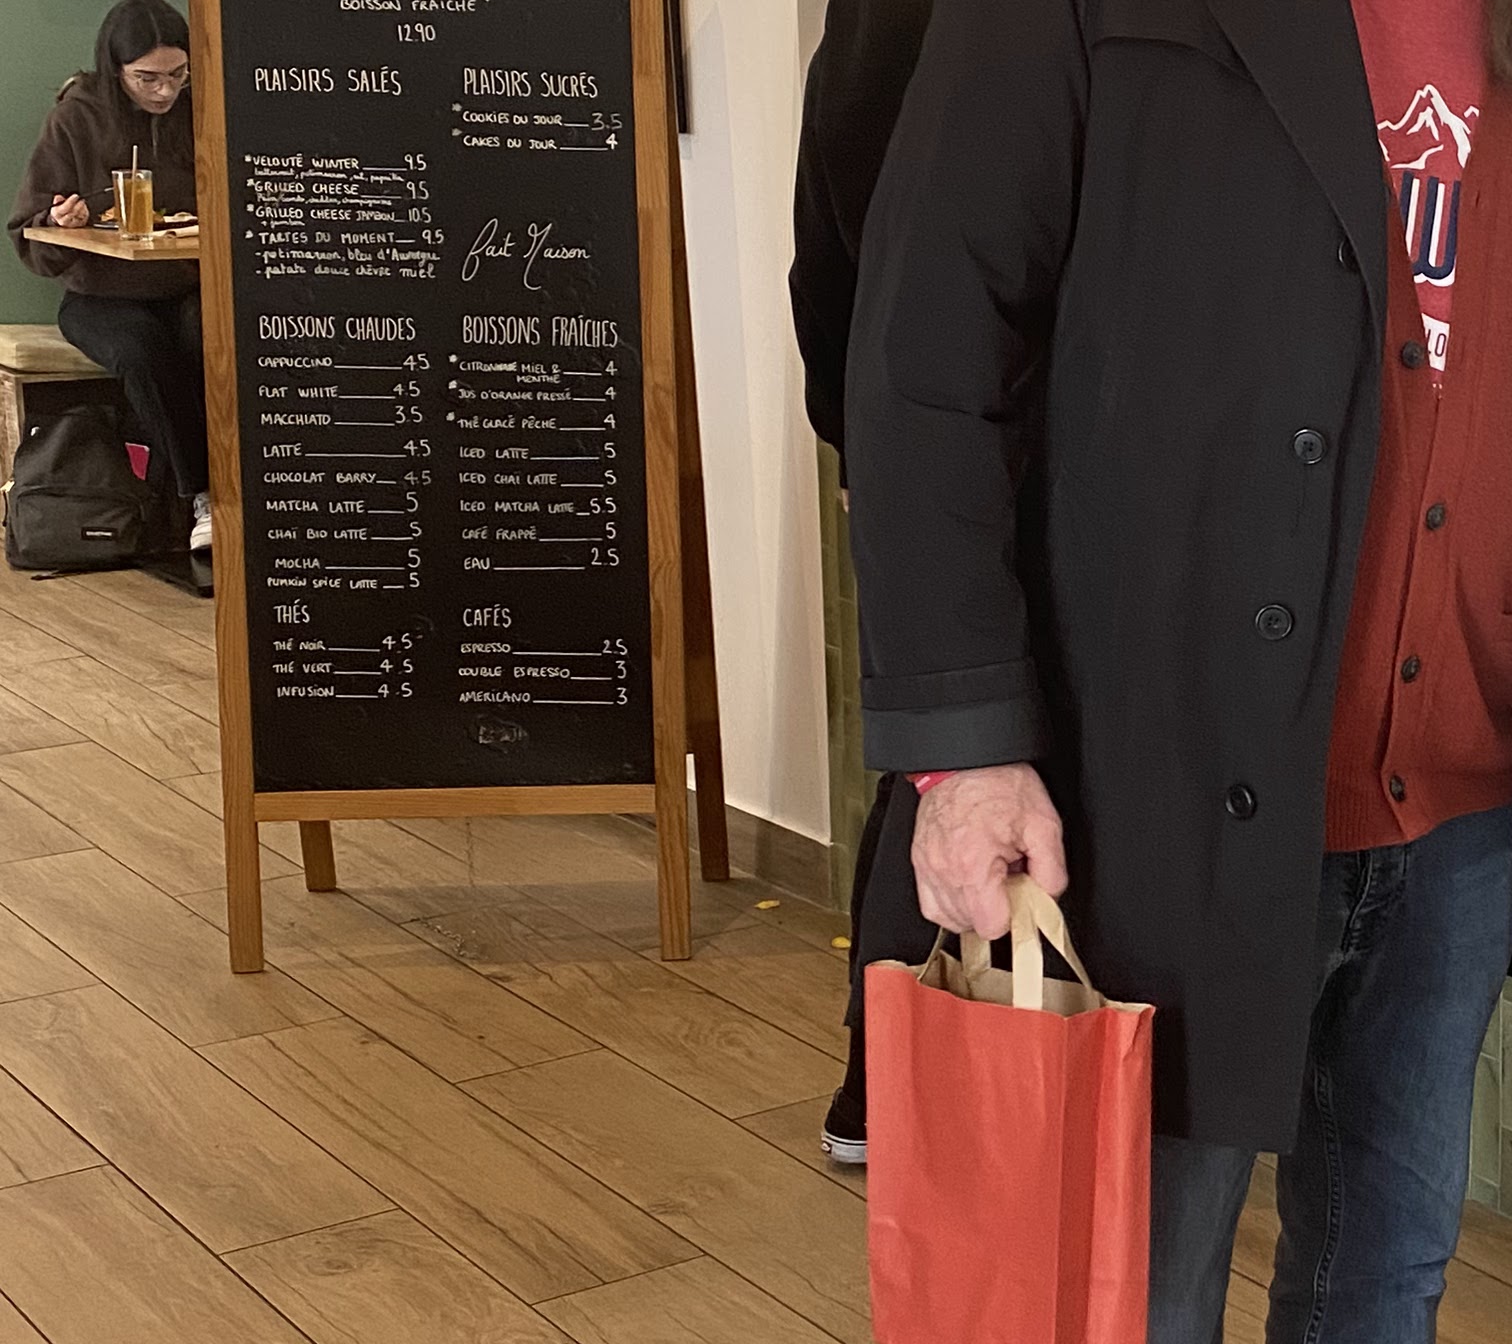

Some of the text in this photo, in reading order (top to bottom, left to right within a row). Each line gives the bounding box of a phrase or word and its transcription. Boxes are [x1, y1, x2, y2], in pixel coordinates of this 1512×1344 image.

[255, 66, 402, 96] PLAISIRS SALÉS
[464, 67, 598, 98] PLAISIRS SUCRÉS
[513, 114, 528, 124] DU
[533, 115, 563, 126] JOUR
[591, 112, 623, 131] 3.5
[463, 133, 618, 150] CAKES DU JOUR 4
[253, 153, 427, 171] VELOUTÉ WINTER 9.5
[254, 181, 305, 194] GRILLED
[312, 183, 359, 195] CHEESE
[255, 206, 304, 219] GRILLED
[310, 208, 352, 221] CHEESE
[258, 229, 444, 245] TARTES DU MOMENT 9.5
[400, 263, 436, 278] miel
[259, 315, 416, 341] BOISSONS CHAUDES
[463, 315, 540, 345] BOISSONS
[258, 357, 333, 368] CAPPUCCINO
[552, 364, 561, 374] &
[605, 360, 618, 376] 4
[516, 374, 560, 383] MENTHE
[258, 380, 420, 398] FLAT WHITE 4.5
[458, 388, 476, 399] JUS
[537, 388, 571, 401] PRESSÉ
[605, 386, 617, 400] 4
[260, 406, 423, 426] MACCHIATO 3.5
[522, 416, 556, 429] PÊCHE
[604, 413, 616, 429] 4
[263, 439, 431, 458] LATTE 4.5
[459, 442, 616, 459] ICED LATTE 5
[264, 470, 431, 485] CHOCOLAT BARRY 4.5
[459, 472, 486, 484] ICED
[527, 473, 558, 485] LATTE
[604, 470, 617, 485] 5
[266, 492, 418, 513] MATCHA LATTE 5
[459, 497, 617, 514] ICED MATCHA LATTE 5.5
[306, 528, 328, 540] BIO
[334, 528, 367, 541] LATTE
[410, 522, 422, 537] 5
[462, 522, 616, 540] CAFÉ FRAPPÉ 5
[275, 548, 421, 569] MOCHA 5
[464, 547, 620, 570] EAU 2.5
[350, 579, 378, 589] LATTE
[409, 572, 420, 588] 5
[273, 599, 310, 624] THÉS
[463, 603, 512, 628] CAFÉS
[273, 638, 294, 651] THÉ
[460, 638, 628, 655] ESPRESSO 2.5
[272, 661, 295, 674] THÉ
[302, 662, 332, 674] VERT
[458, 660, 627, 679] DOUBLE ESPRESSO 3
[616, 687, 628, 705] 3
